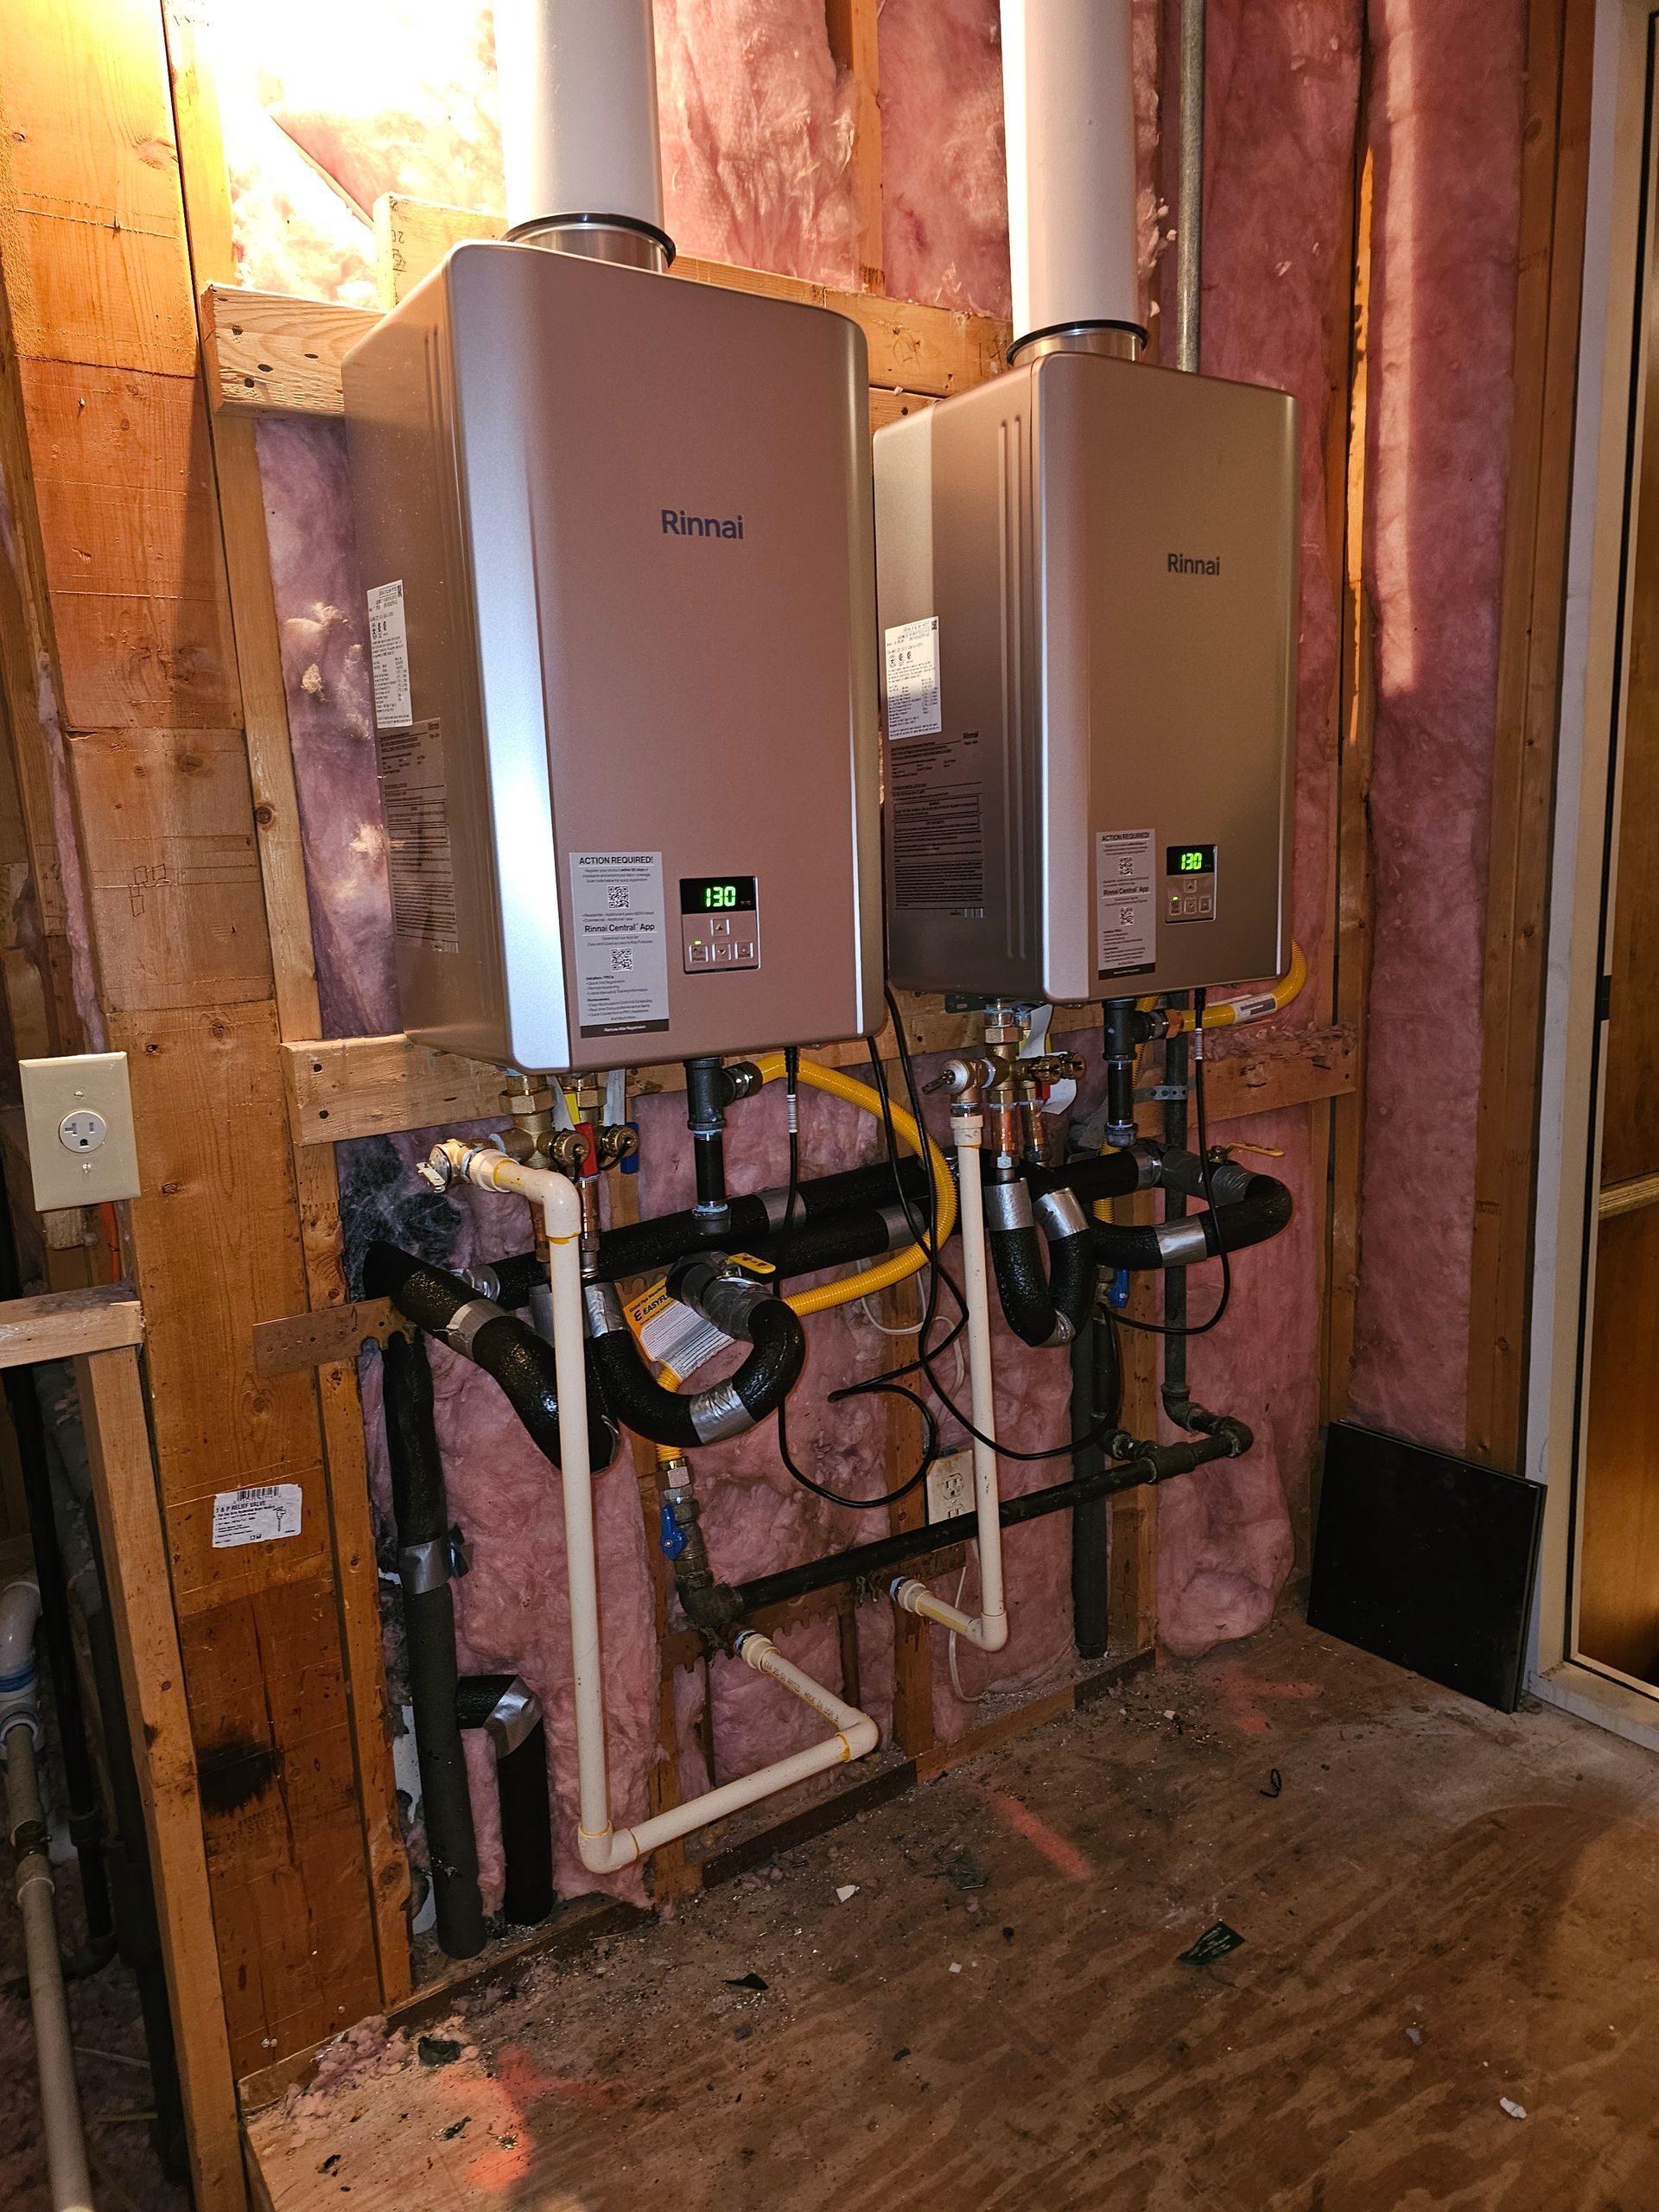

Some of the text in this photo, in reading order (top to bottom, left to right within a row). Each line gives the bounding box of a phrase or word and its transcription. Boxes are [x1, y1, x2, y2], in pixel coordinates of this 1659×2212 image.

[661, 509, 744, 540] Rinnai
[1167, 553, 1220, 576] Rinnai
[1181, 852, 1202, 870] 130
[706, 886, 736, 907] 130
